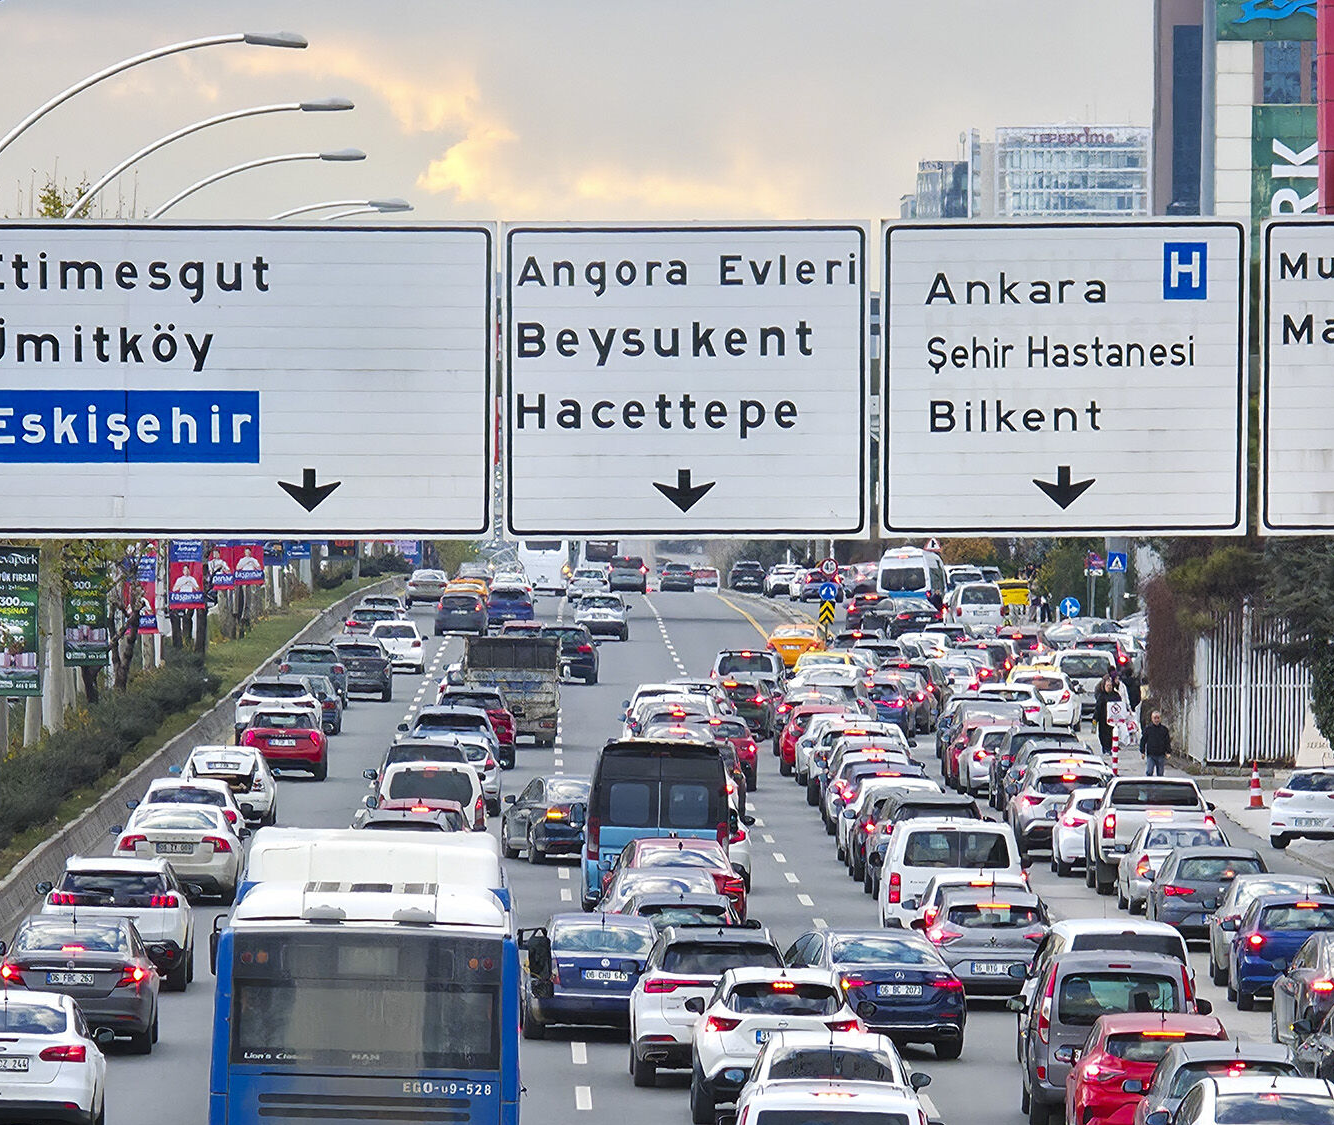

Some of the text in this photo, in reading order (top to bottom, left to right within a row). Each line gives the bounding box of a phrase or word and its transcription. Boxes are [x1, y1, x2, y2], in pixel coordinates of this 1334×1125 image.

[518, 253, 855, 296] Angora Evleri
[926, 273, 1105, 304] Ankara
[518, 322, 812, 366] Beysukent
[928, 336, 1193, 374] Şehir Hastanesi
[517, 394, 797, 438] Hacettepe
[931, 400, 1100, 432] Bilkent
